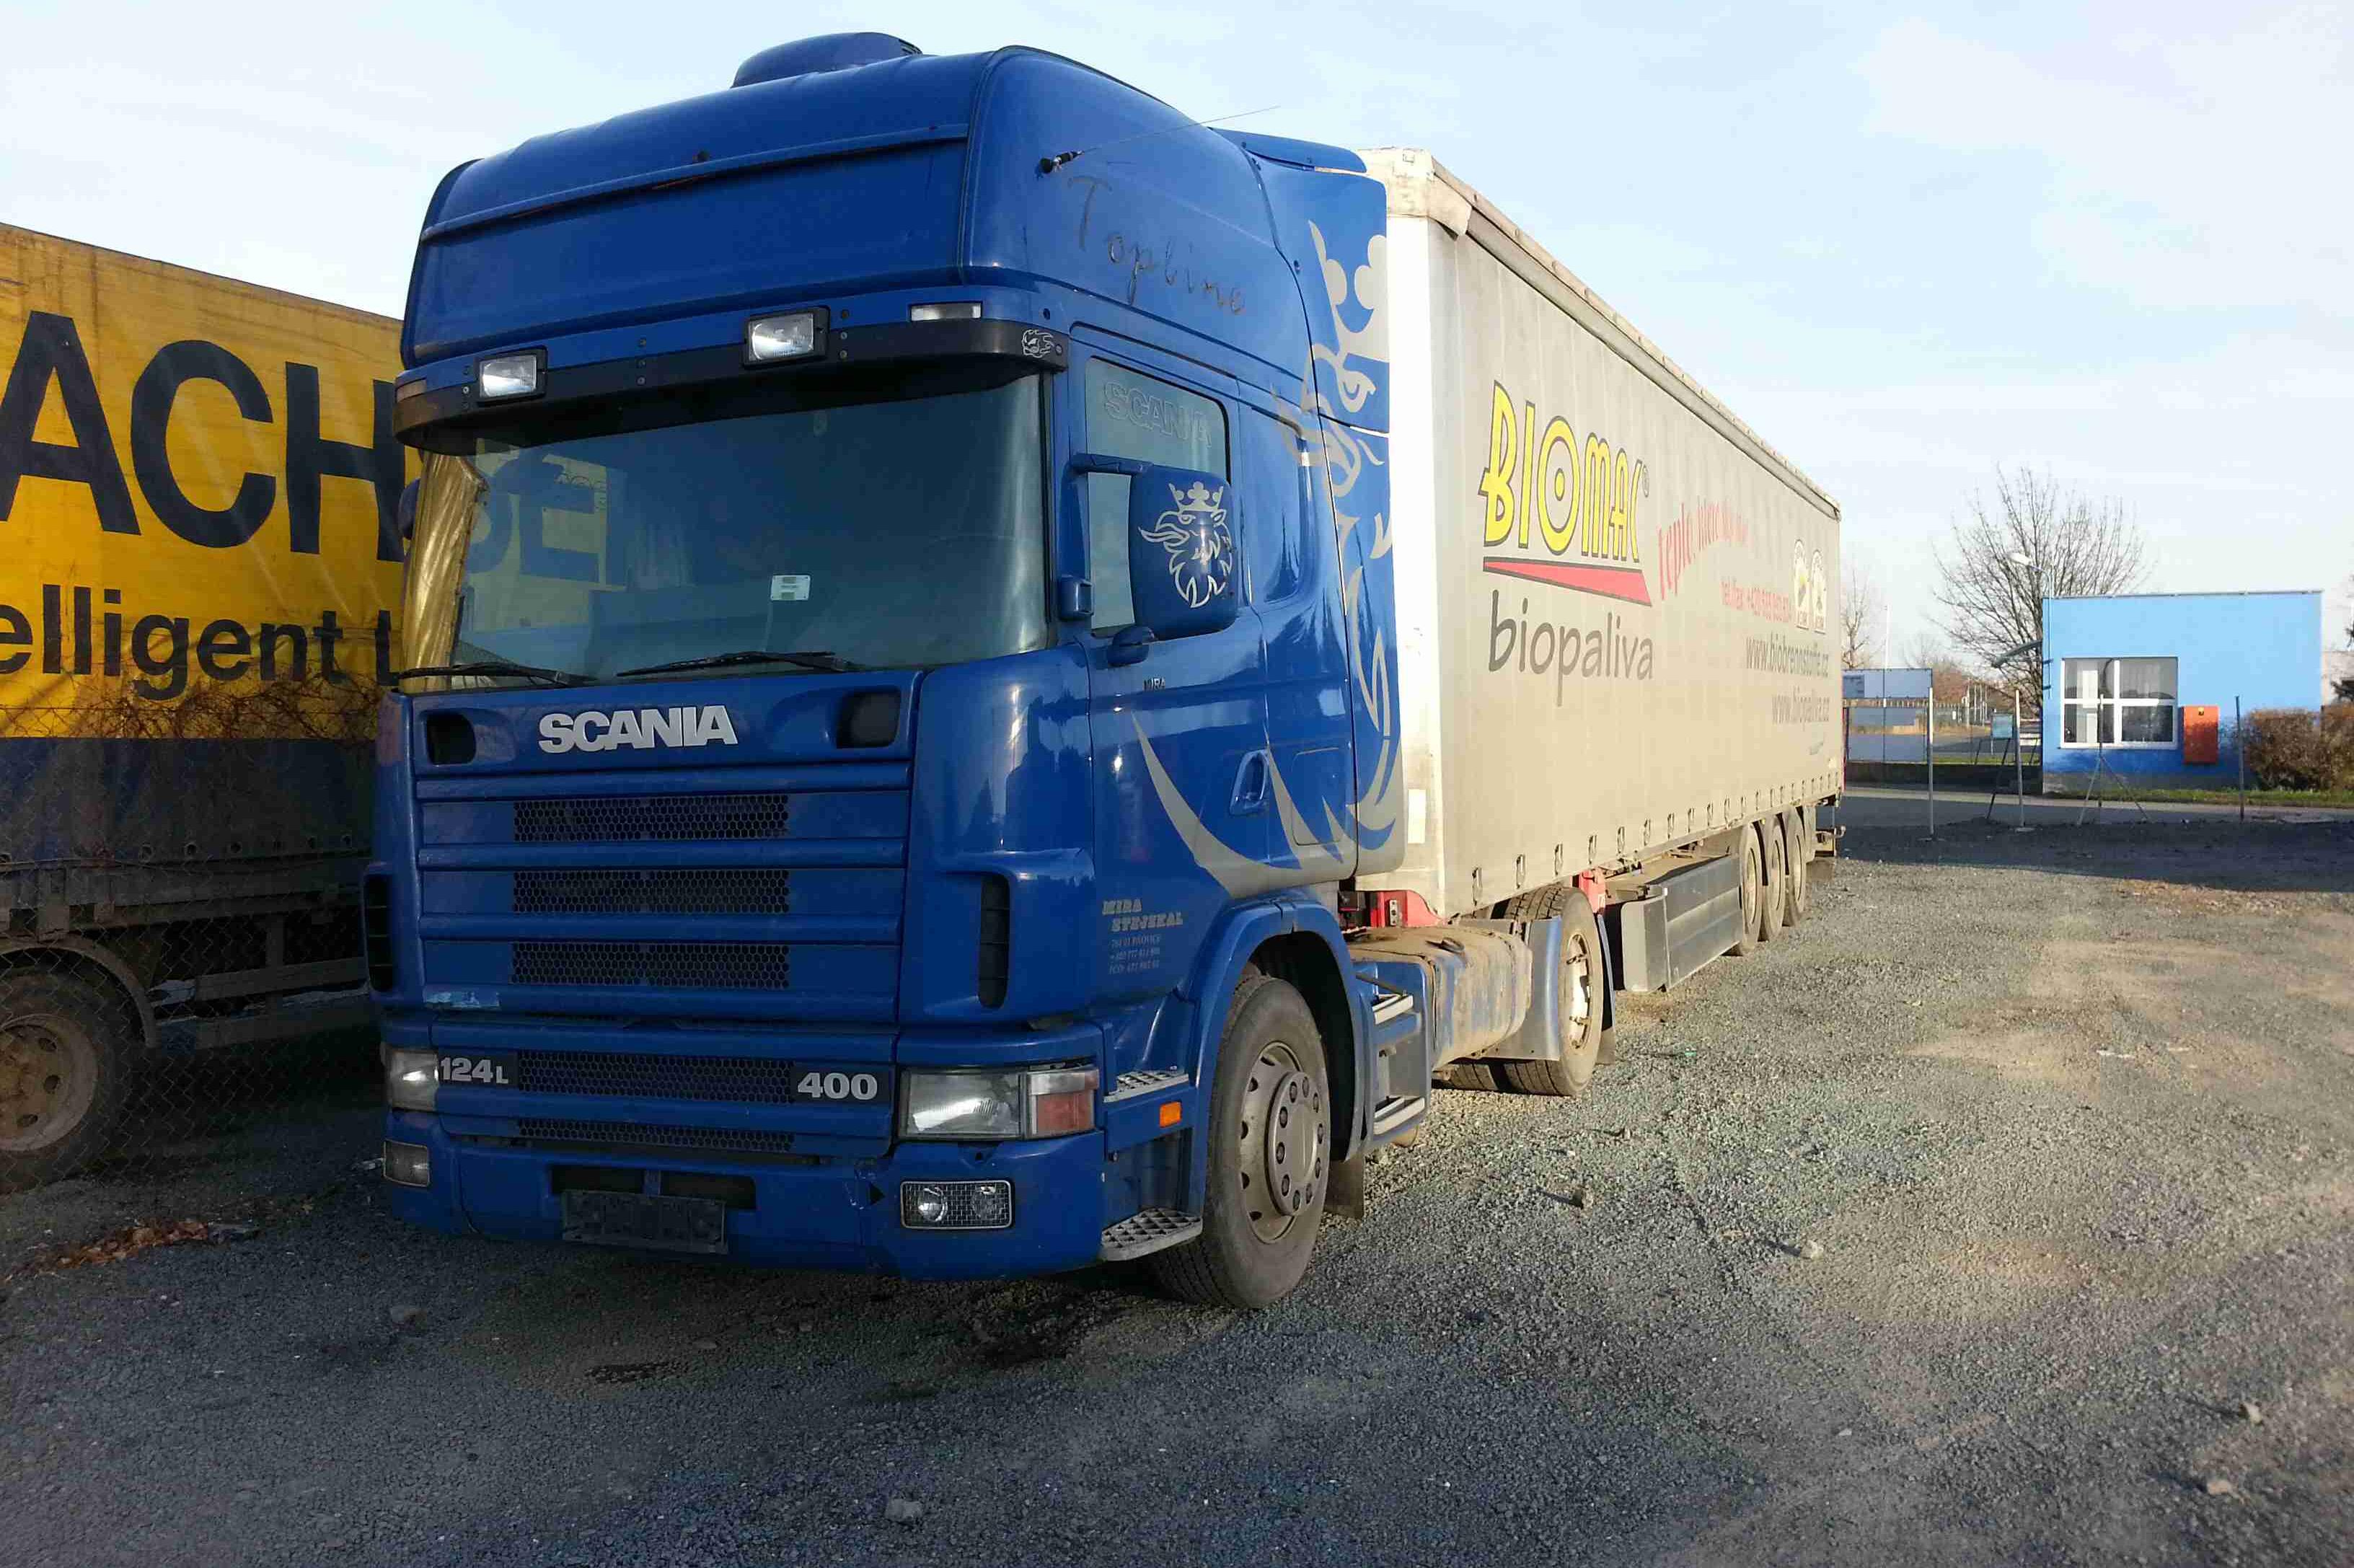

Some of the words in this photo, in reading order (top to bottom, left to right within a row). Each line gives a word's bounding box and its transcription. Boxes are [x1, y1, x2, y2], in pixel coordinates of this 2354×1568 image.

[1487, 589, 1654, 708] biopaliva
[539, 705, 738, 754] SCANIA
[796, 1070, 878, 1101] 400
